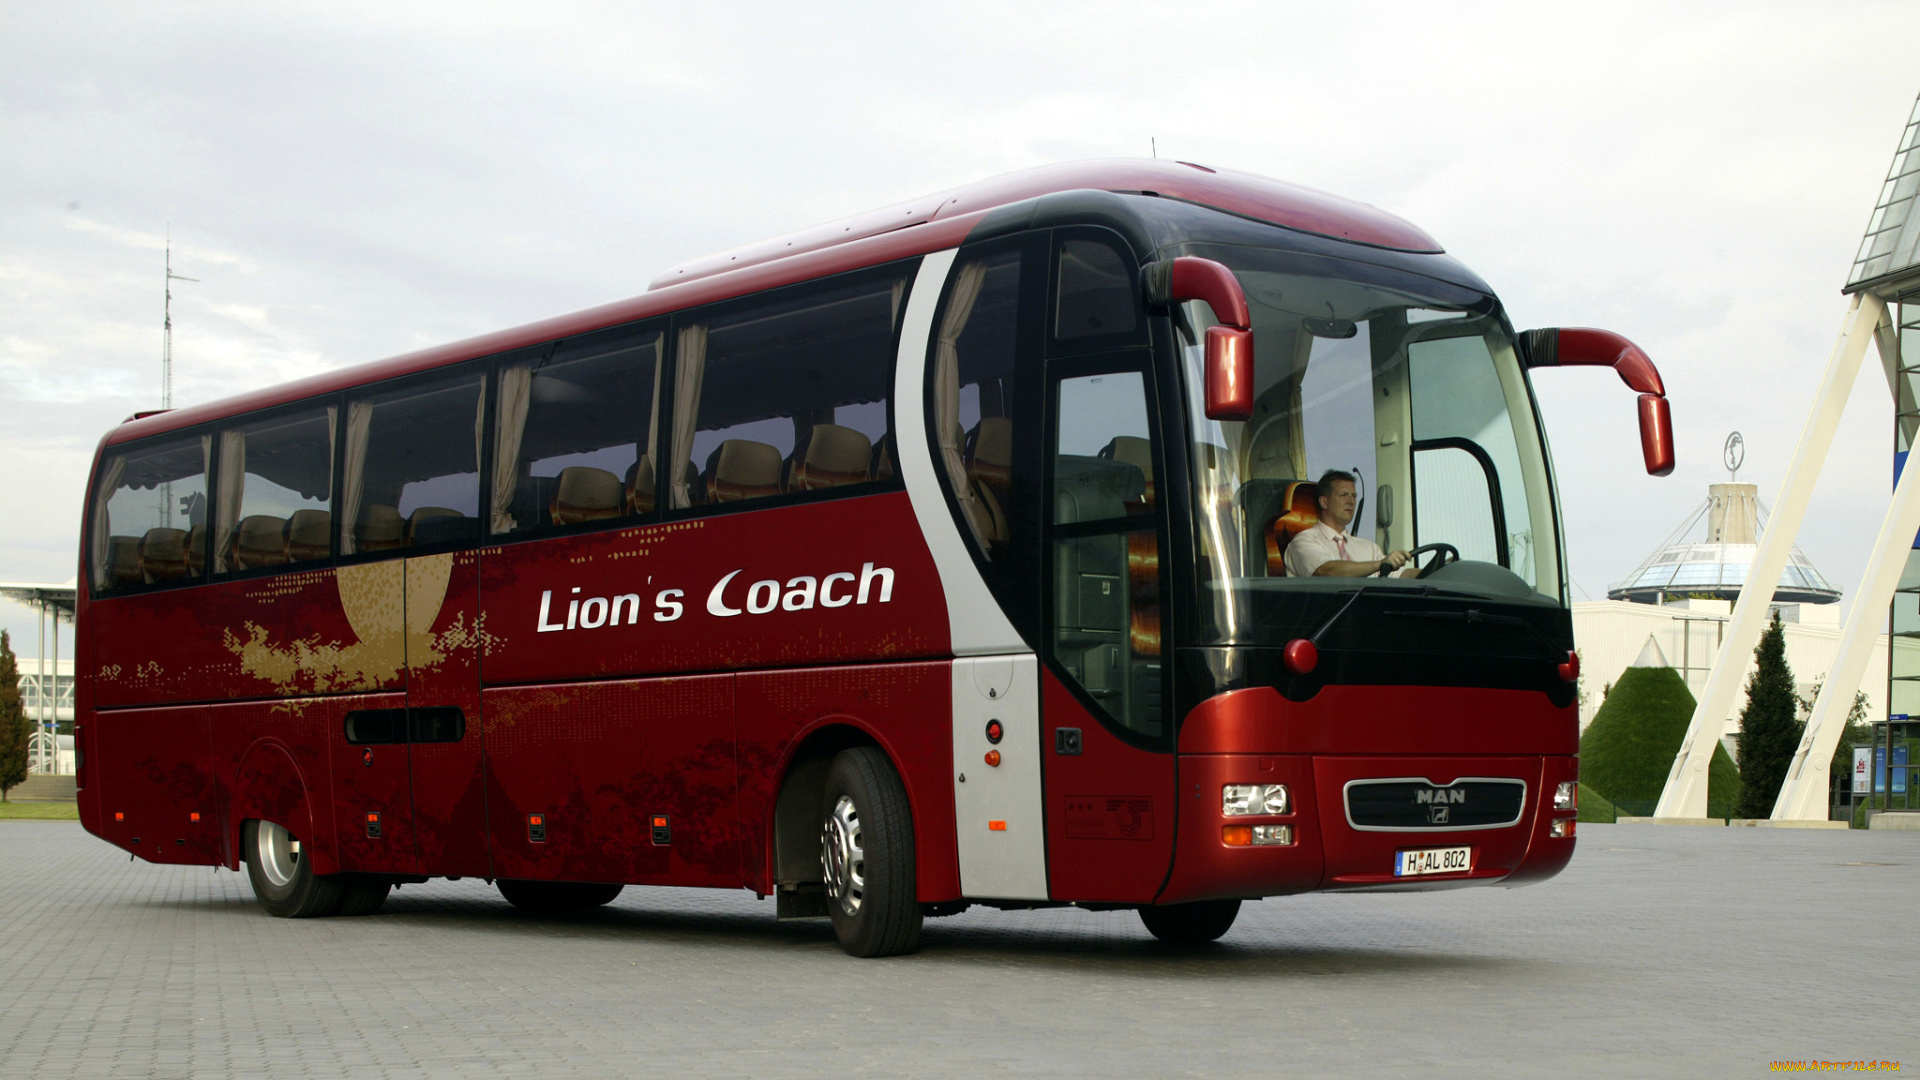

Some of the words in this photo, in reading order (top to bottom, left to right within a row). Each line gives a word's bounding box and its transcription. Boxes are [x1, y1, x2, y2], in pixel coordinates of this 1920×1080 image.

[537, 575, 685, 633] Lion's
[706, 562, 895, 617] Coach
[1416, 789, 1465, 804] MAN
[1407, 853, 1417, 872] H
[1424, 852, 1440, 870] AL
[1443, 850, 1466, 869] 802
